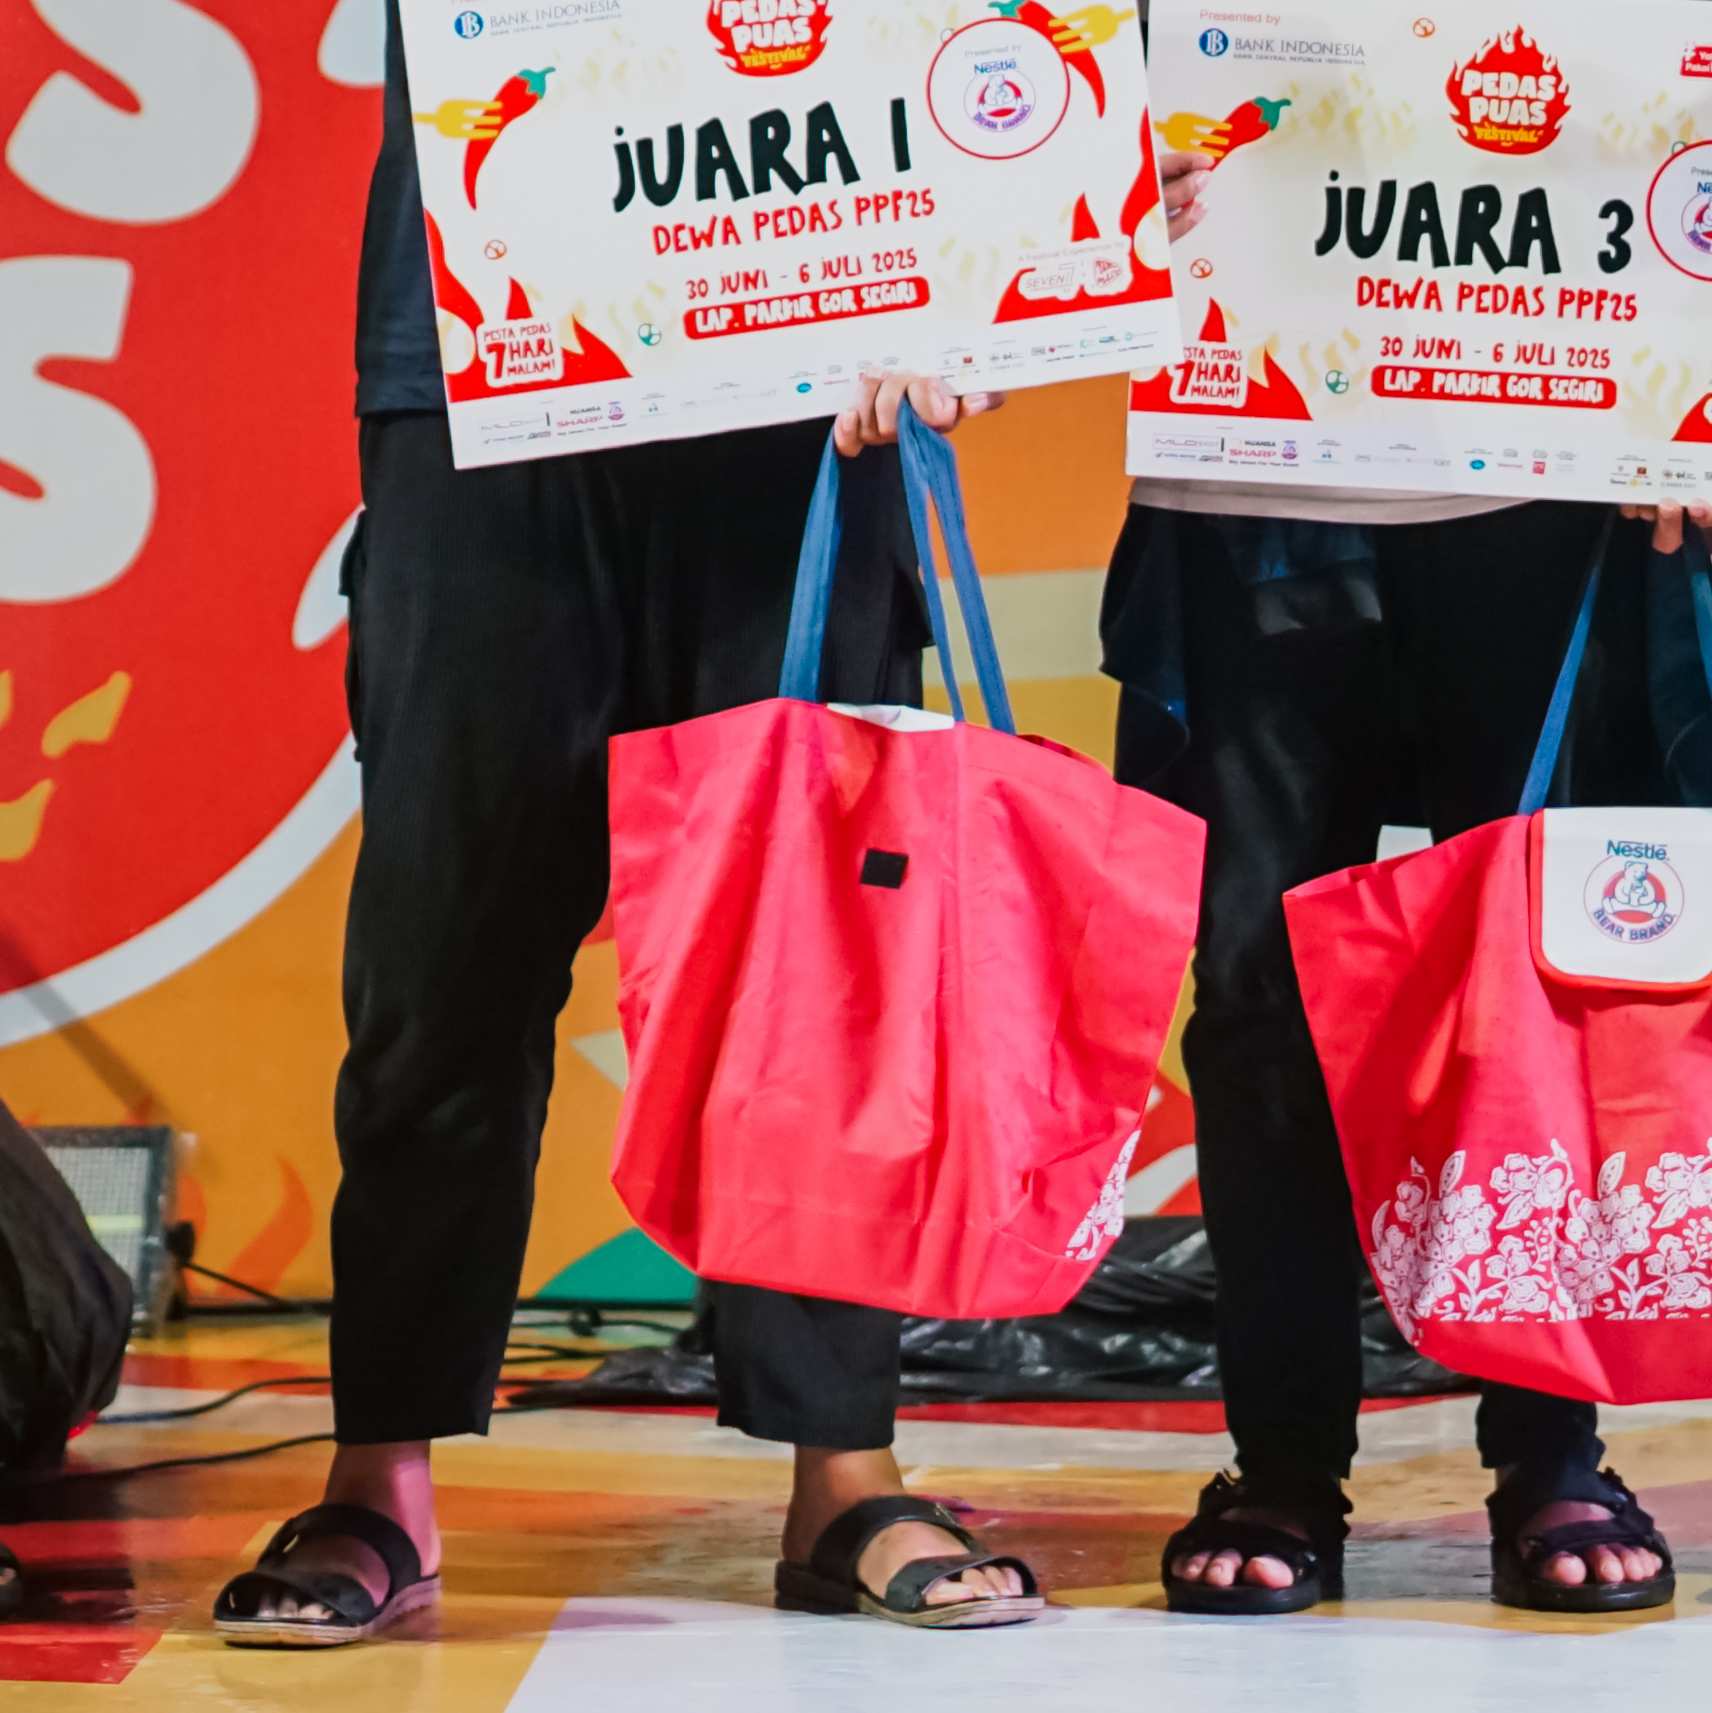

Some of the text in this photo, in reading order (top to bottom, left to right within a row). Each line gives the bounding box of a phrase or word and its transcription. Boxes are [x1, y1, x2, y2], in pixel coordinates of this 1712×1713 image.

[490, 11, 531, 29] BANK
[1199, 9, 1281, 26] Presented by
[730, 17, 812, 53] PUAS
[1234, 38, 1365, 58] BANK INDONESIA
[1461, 69, 1557, 101] PEDAS
[1468, 96, 1547, 126] PUAS
[652, 188, 935, 256] DEWA PEDAS PPF25
[1597, 199, 1634, 274] 3
[686, 279, 709, 300] 30
[799, 264, 810, 284] 6
[872, 248, 917, 274] 2025
[695, 280, 917, 334] LAP. PARKIR GOR SEGIRI
[1356, 275, 1638, 322] DEWA PEDAS PPF25
[483, 322, 552, 342] PESTA PEDAS
[487, 339, 554, 379] 7 HARI
[507, 360, 556, 377] MALAM!
[1184, 346, 1243, 361] STA PEDAS
[1380, 336, 1403, 358] 30
[1492, 343, 1504, 363] 6
[1566, 348, 1610, 369] 2025
[1175, 361, 1241, 396] 7 HARI
[1191, 384, 1240, 399] MALAM!
[1384, 368, 1604, 404] LAP. PARKIR GOR SEGIRI
[1606, 839, 1668, 861] Nestlé
[1593, 909, 1675, 941] BEAR BRAND
